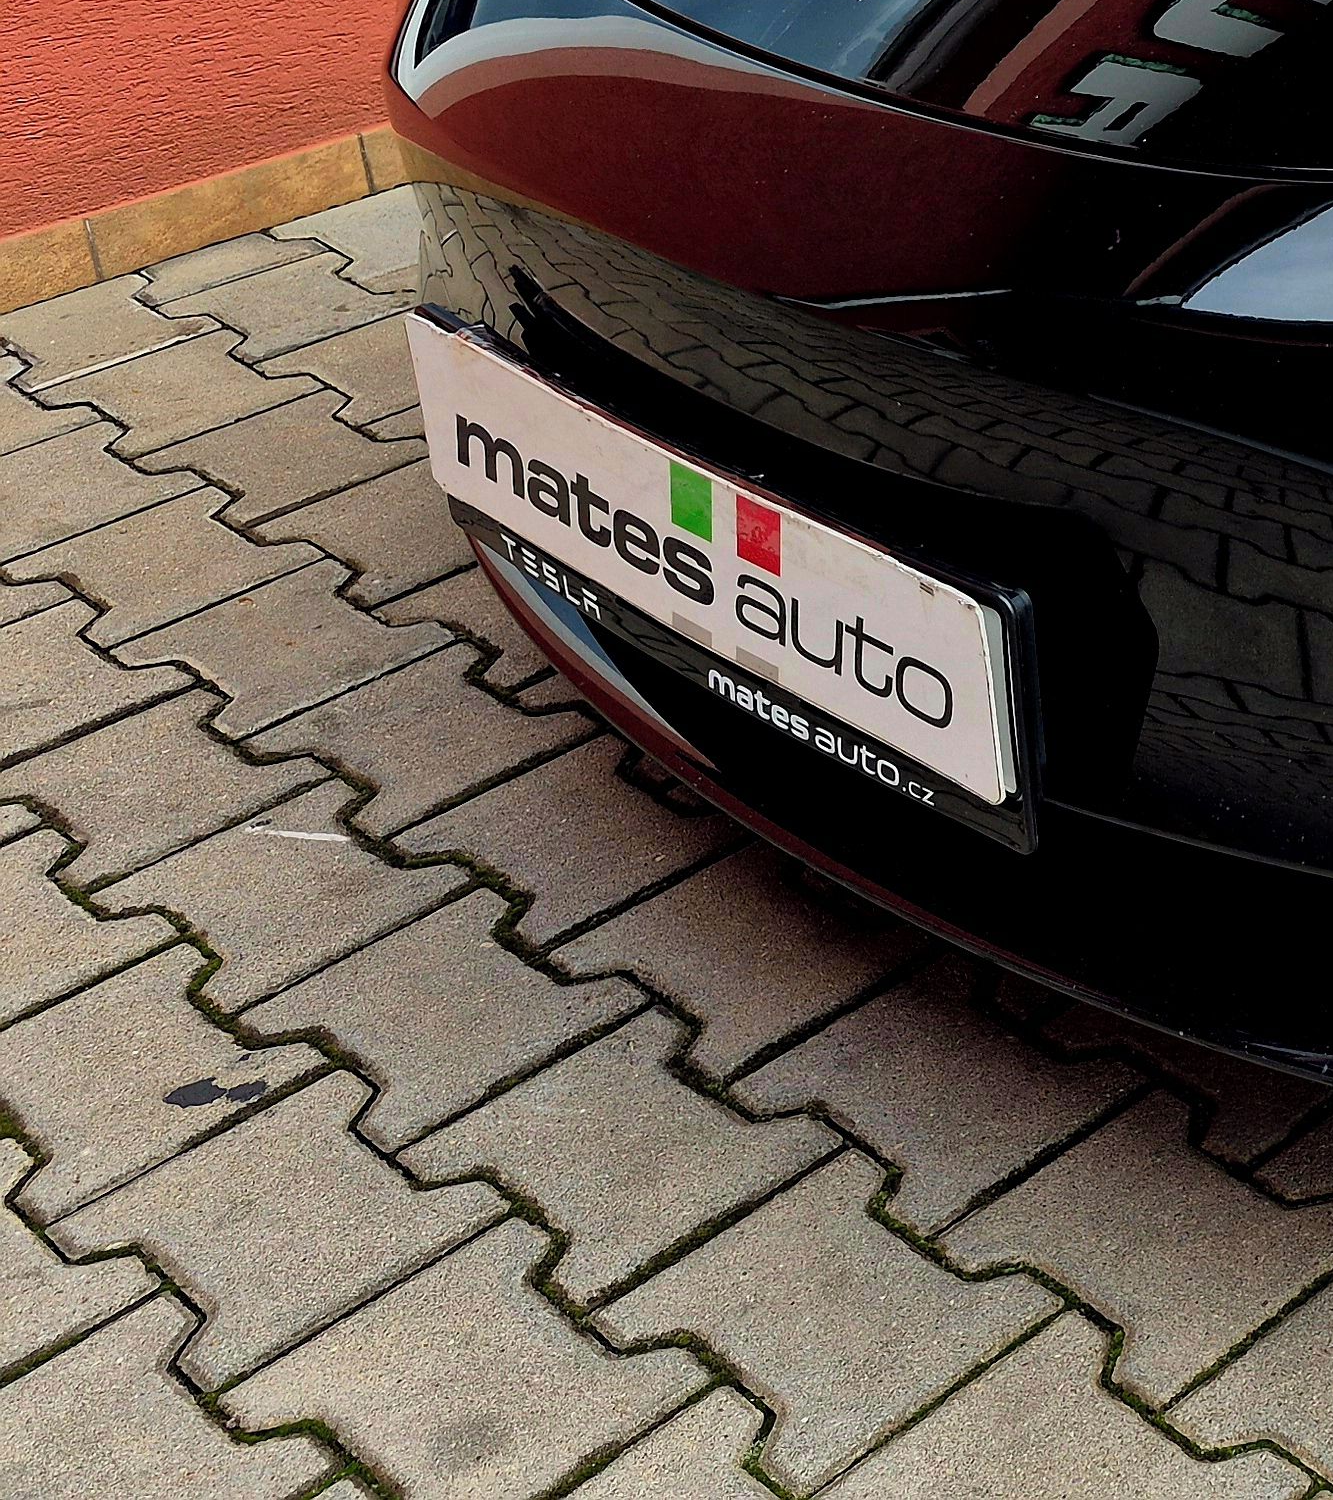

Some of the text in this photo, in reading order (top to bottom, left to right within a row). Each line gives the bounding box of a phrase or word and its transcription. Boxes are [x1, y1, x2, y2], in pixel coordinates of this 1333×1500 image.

[455, 414, 953, 729] mates auto
[499, 533, 602, 620] TESLA
